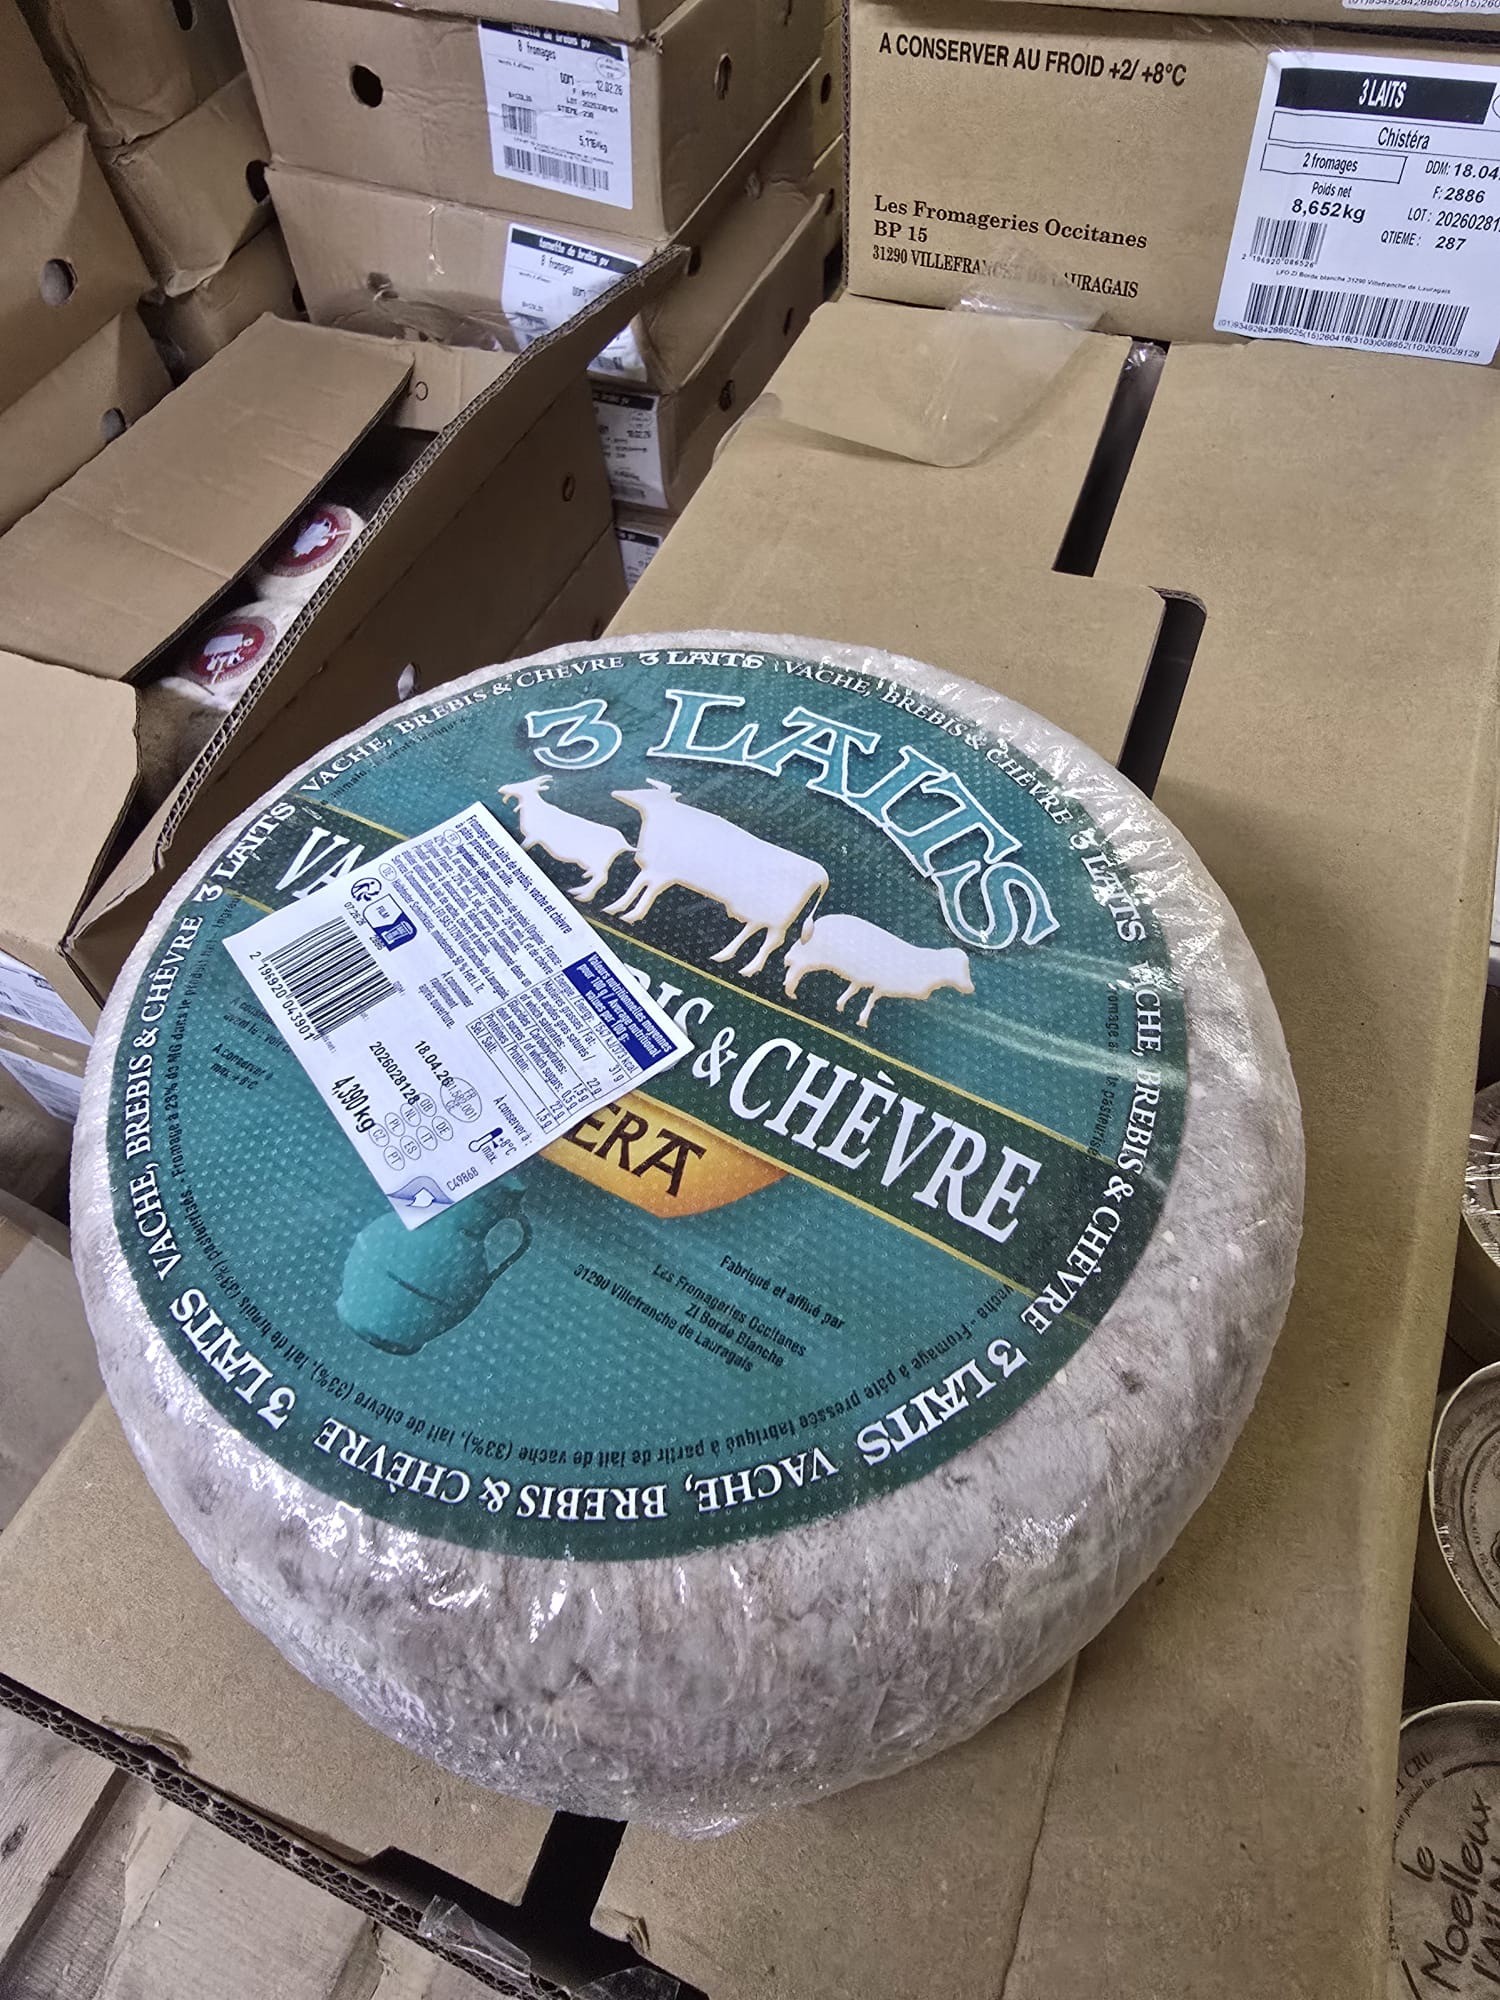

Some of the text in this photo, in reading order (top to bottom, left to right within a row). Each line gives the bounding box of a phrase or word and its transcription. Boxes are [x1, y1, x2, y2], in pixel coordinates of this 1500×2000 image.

[879, 32, 892, 54] A
[896, 34, 1010, 68] CONSERVER
[1013, 47, 1041, 71] AU
[1046, 50, 1105, 78] FROID
[1142, 63, 1187, 86] +8°C
[1359, 79, 1408, 109] 3 LAITS
[1377, 126, 1430, 150] Chistéra
[1303, 152, 1359, 174] 2 fromages
[1311, 181, 1352, 198] Poids net
[1444, 187, 1486, 203] 2886
[873, 220, 928, 243] BP 15
[874, 195, 1148, 249] Les Fromageries Occitanes
[1435, 211, 1500, 233] 20260281
[872, 244, 907, 264] 31290
[1435, 236, 1467, 251] 287
[639, 651, 1074, 825] 3 LAITS VACHE, BREBIS & CHÈVRE
[194, 883, 225, 903] 3
[211, 802, 296, 880] LAITS
[300, 736, 393, 793] VACHE,
[394, 691, 487, 735] BREBIS
[492, 682, 512, 695] &
[516, 657, 625, 688] CHÈVRE
[524, 698, 623, 770] 3
[646, 689, 1060, 950] LAITS
[1069, 828, 1098, 851] 3
[528, 886, 548, 907] vache
[543, 904, 556, 914] et
[1081, 853, 1147, 943] LAITS
[548, 911, 572, 934] chèvre
[248, 950, 262, 960] 2
[257, 963, 287, 998] 196920
[281, 999, 314, 1040] 043901
[584, 989, 615, 1022] values per
[587, 953, 672, 1052] Valeurs nutritionnelles moyennes
[540, 1000, 589, 1057] acides gras saturés
[558, 1005, 583, 1030] grasses
[607, 998, 661, 1057] Average nutritional
[469, 1020, 497, 1054] Sel Salt:
[369, 1041, 420, 1105] 2026028128
[414, 1040, 454, 1087] 18.04.26
[528, 1048, 548, 1069] which
[331, 1075, 376, 1133] 4,390 kg
[419, 1097, 450, 1134] GB DE
[497, 1102, 526, 1135] conserver
[1117, 1068, 1161, 1175] BREBIS
[388, 1117, 418, 1154] PL ES
[403, 1107, 433, 1143] NL IT
[692, 1026, 739, 1087] &
[729, 1037, 1043, 1244] CHÈVRE
[371, 1128, 402, 1164] CZ PT
[481, 1145, 497, 1165] max.
[125, 914, 296, 1430] 3 LAITS VACHE, BREBIS & CHÈVRE
[1104, 1175, 1135, 1202] &
[1021, 1207, 1122, 1335] CHÈVRE
[719, 1255, 769, 1290] Fabriqué
[773, 1284, 786, 1297] et
[821, 1311, 846, 1331] par
[610, 1283, 678, 1329] Villefranche
[678, 1322, 694, 1339] de
[694, 1333, 754, 1372] Lauragais
[674, 1275, 748, 1324] Fromageries
[749, 1316, 807, 1357] Occitanes
[700, 1312, 735, 1338] Borde
[736, 1331, 785, 1367] Blanche
[313, 1339, 1028, 1521] 3 LAITS VACHE, BREBIS & CHÈVRE
[1420, 1790, 1492, 1993] Moelleux
